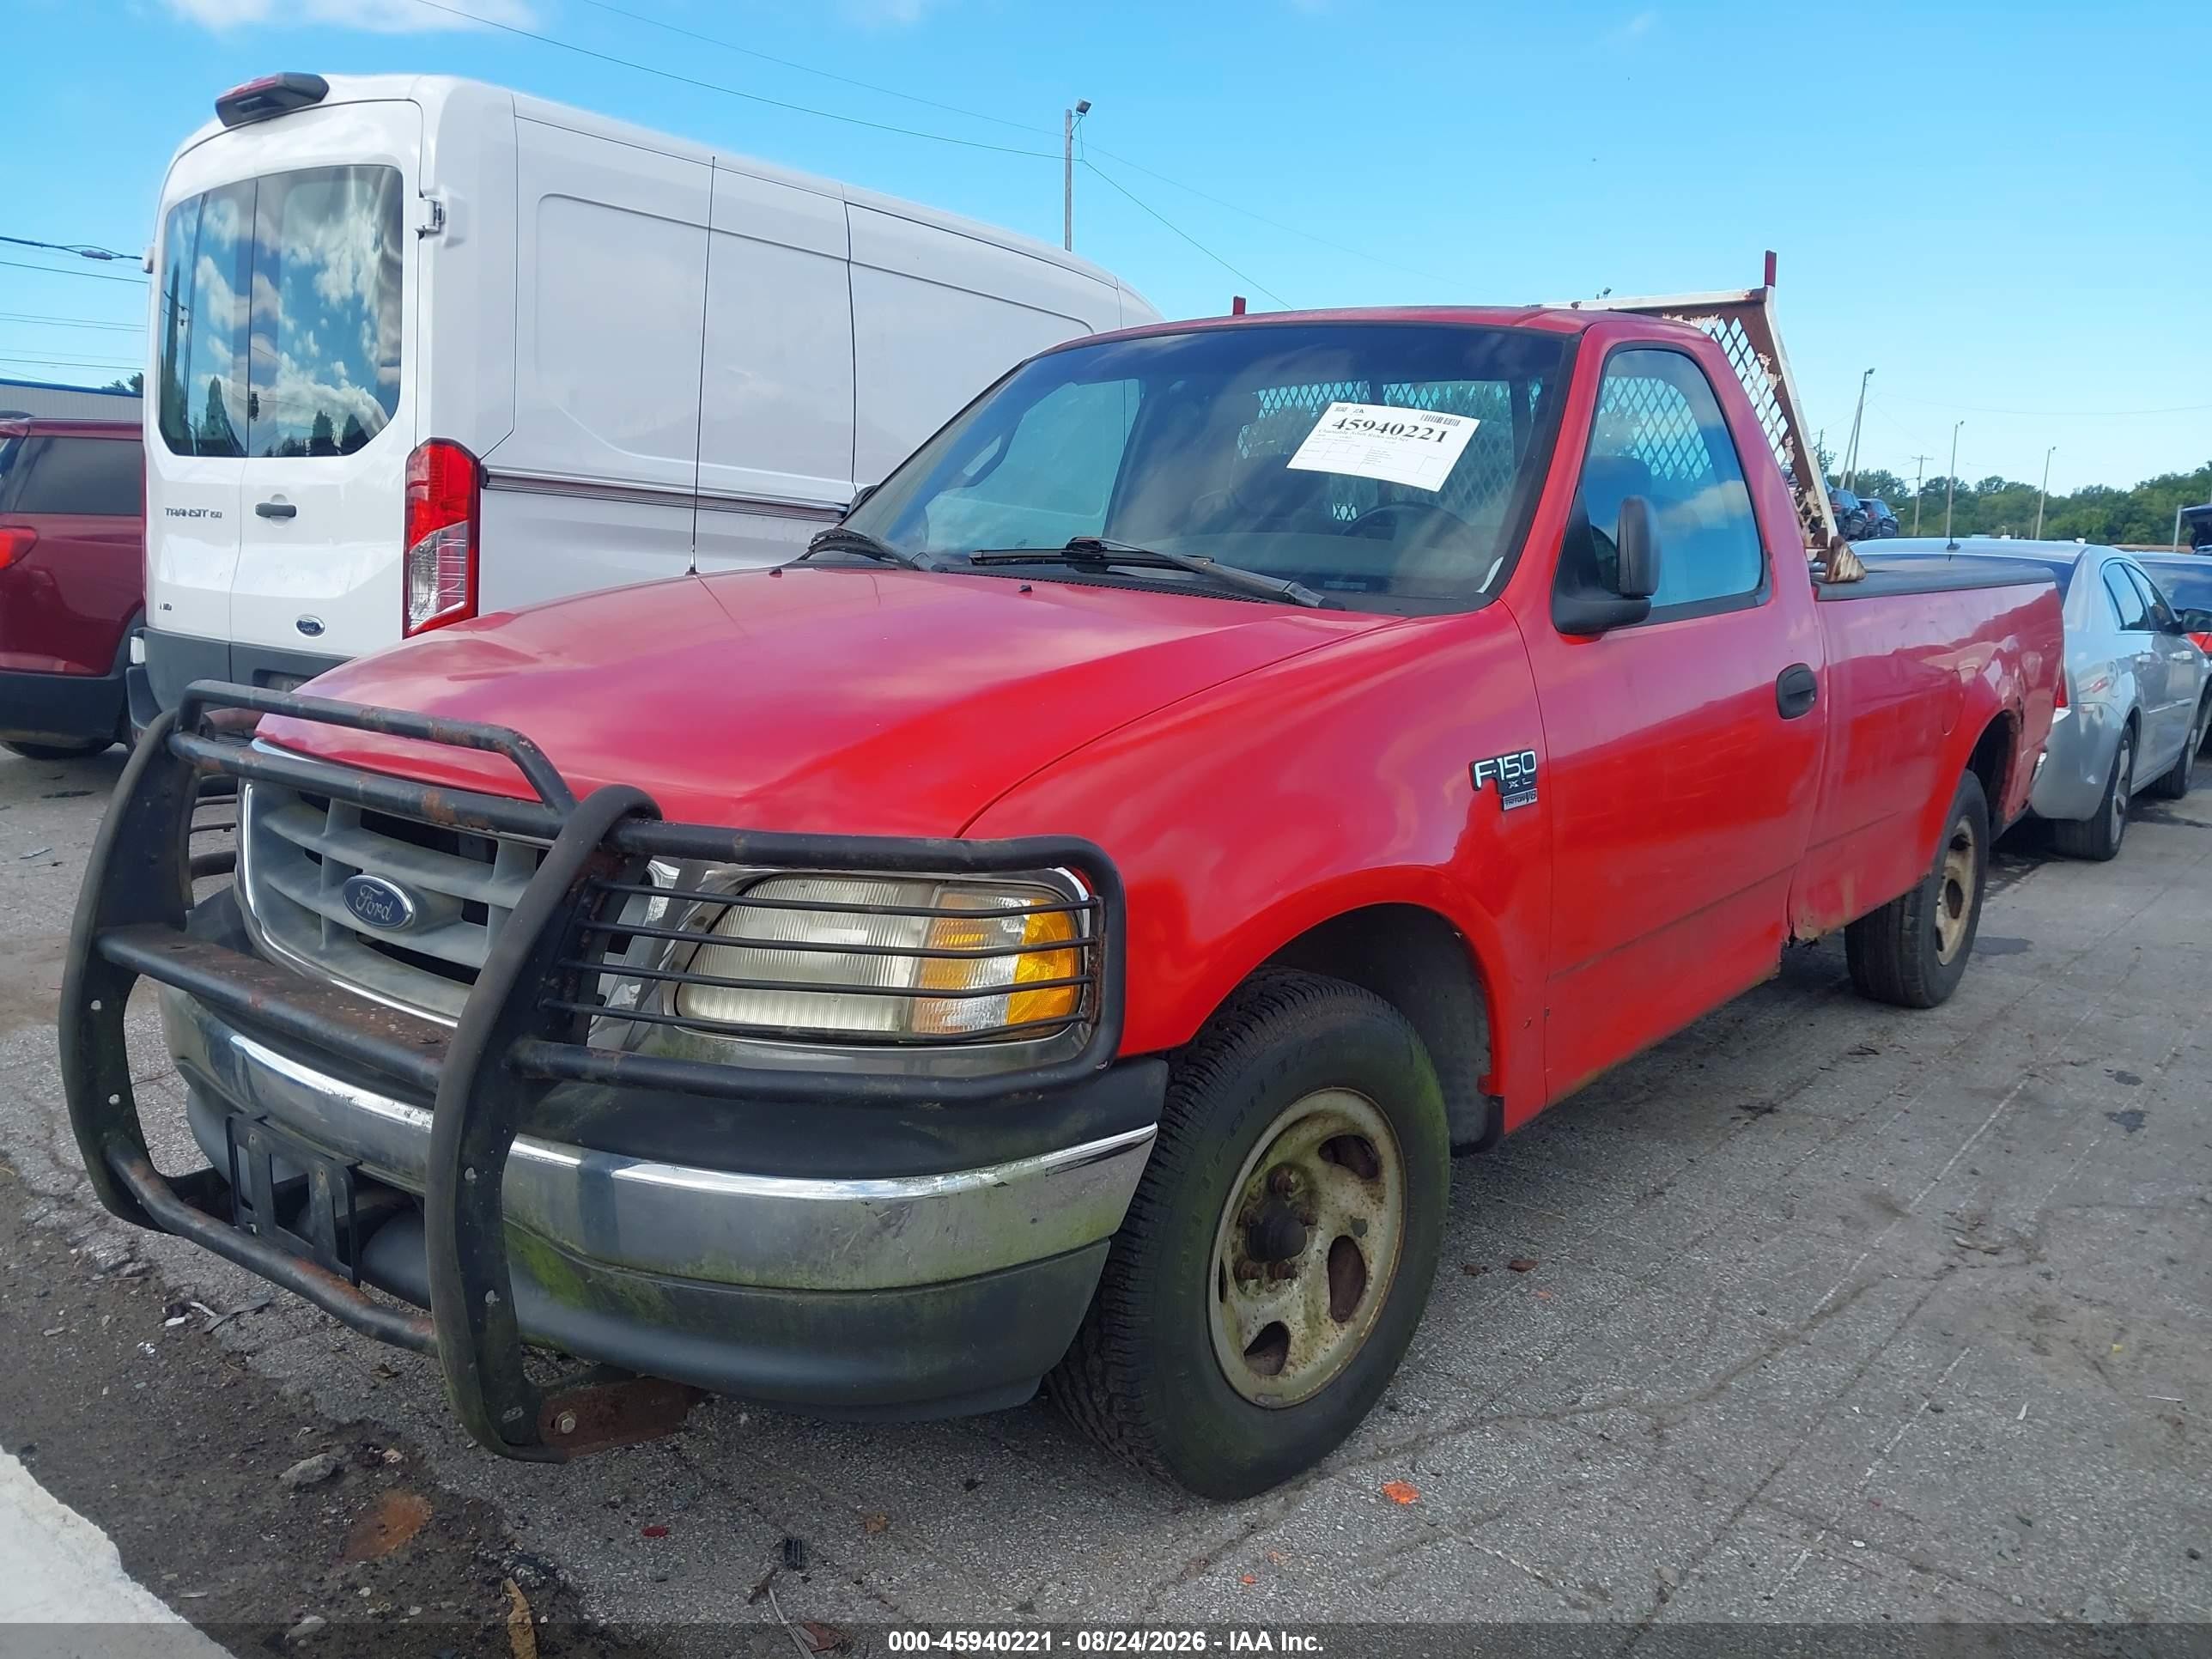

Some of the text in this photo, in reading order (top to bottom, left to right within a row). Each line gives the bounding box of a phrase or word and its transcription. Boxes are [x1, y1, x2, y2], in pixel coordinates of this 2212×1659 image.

[1332, 417, 1449, 443] 45940221
[165, 507, 209, 518] TRANSIT
[1508, 778, 1533, 789] XL
[356, 884, 393, 921] Ford
